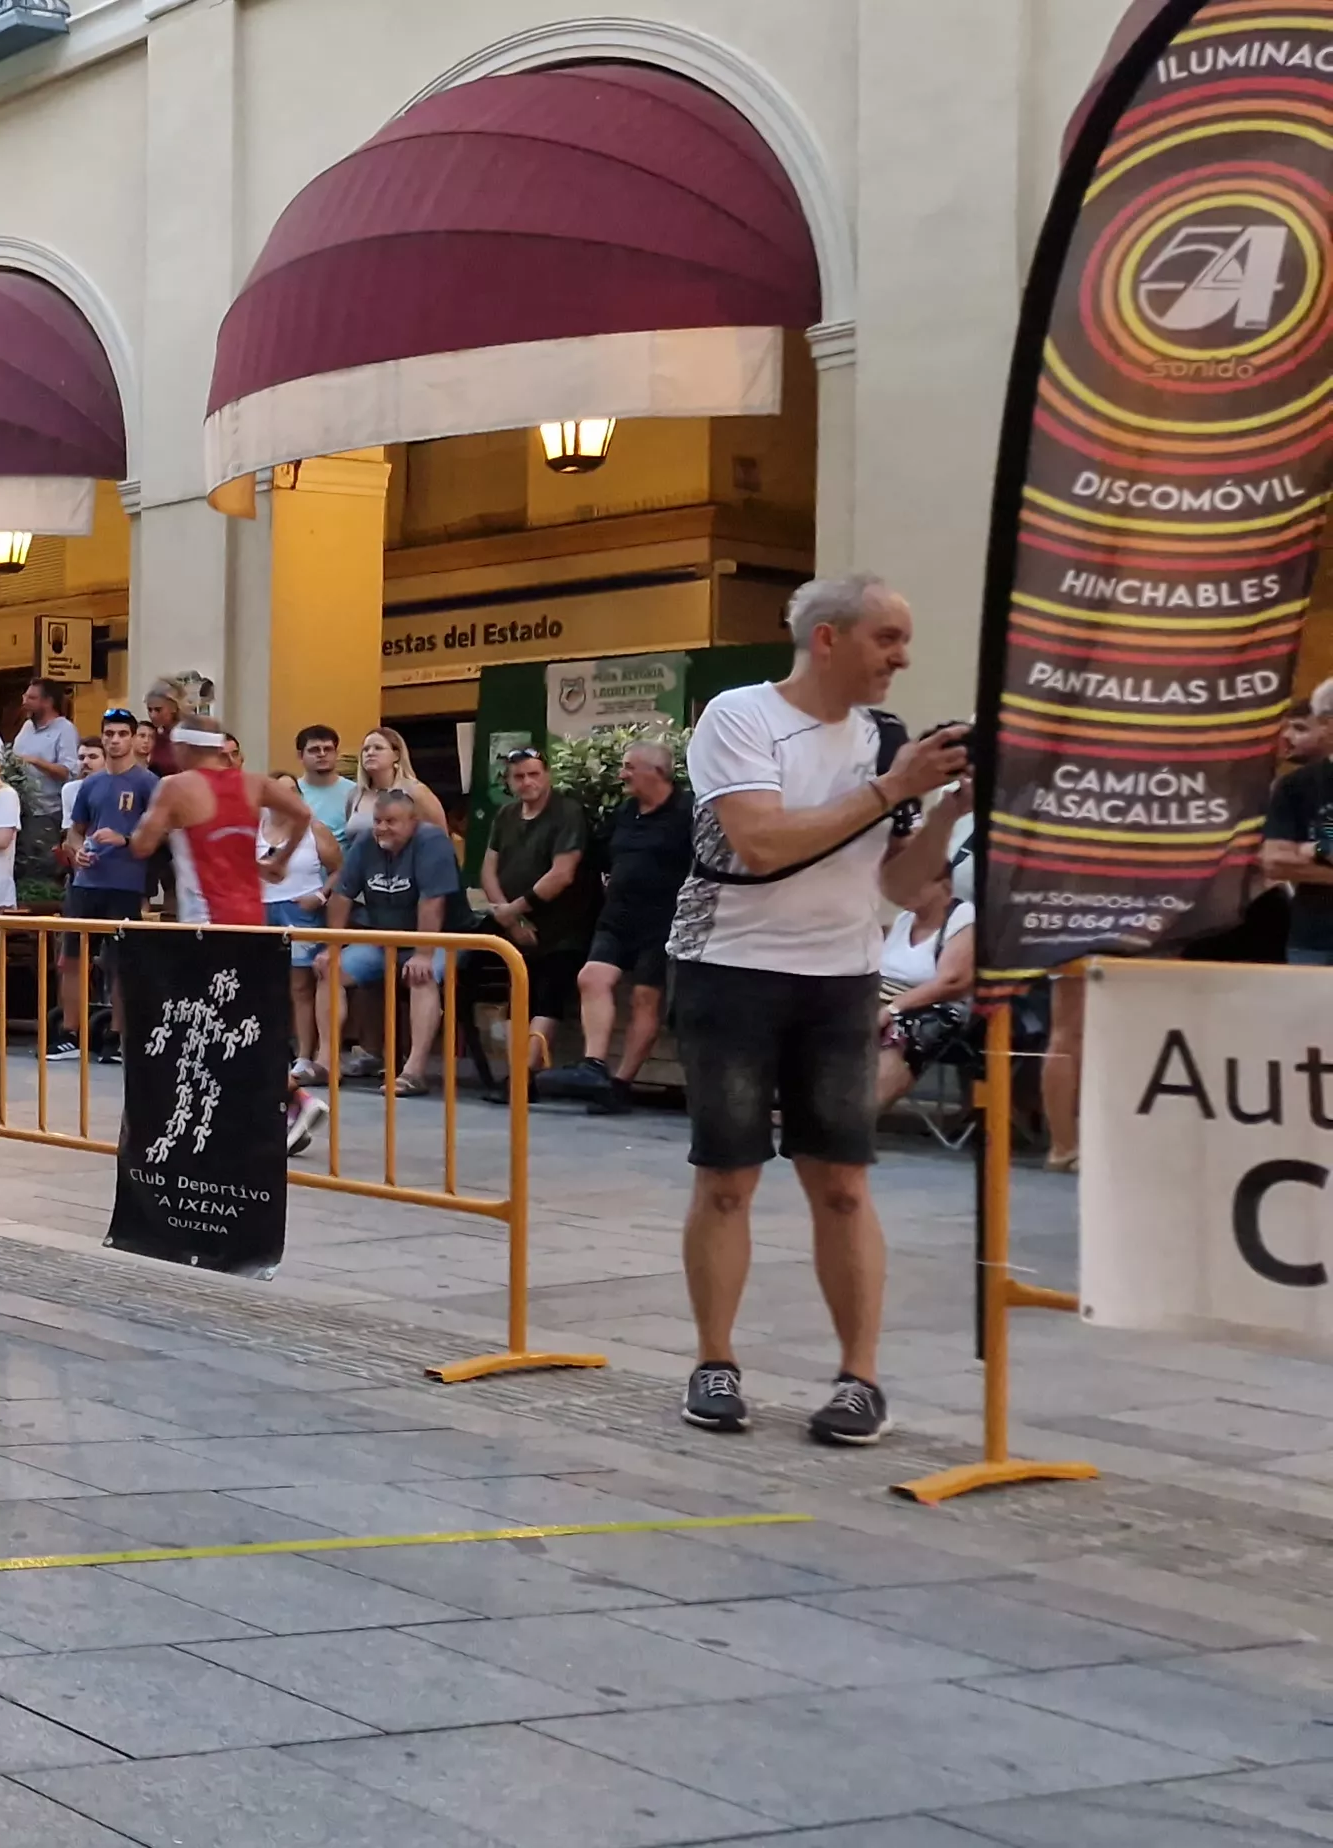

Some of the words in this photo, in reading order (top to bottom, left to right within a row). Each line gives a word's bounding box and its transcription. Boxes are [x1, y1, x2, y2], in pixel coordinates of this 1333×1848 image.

[1139, 225, 1289, 331] 54
[1150, 356, 1256, 380] sonido
[1072, 469, 1306, 512] DISCOMÓVIL
[1059, 569, 1281, 608] HINCHABLES
[444, 623, 477, 649] del
[483, 614, 564, 646] Estado
[1028, 662, 1209, 704] PANTALLAS
[1218, 670, 1280, 702] LED
[1053, 764, 1206, 797] CAMIÓN
[1136, 1029, 1333, 1130] Aut
[129, 1168, 166, 1186] Club
[177, 1176, 270, 1202] Deportivo
[167, 1216, 228, 1235] QUIZENA
[1233, 1158, 1330, 1288] C
